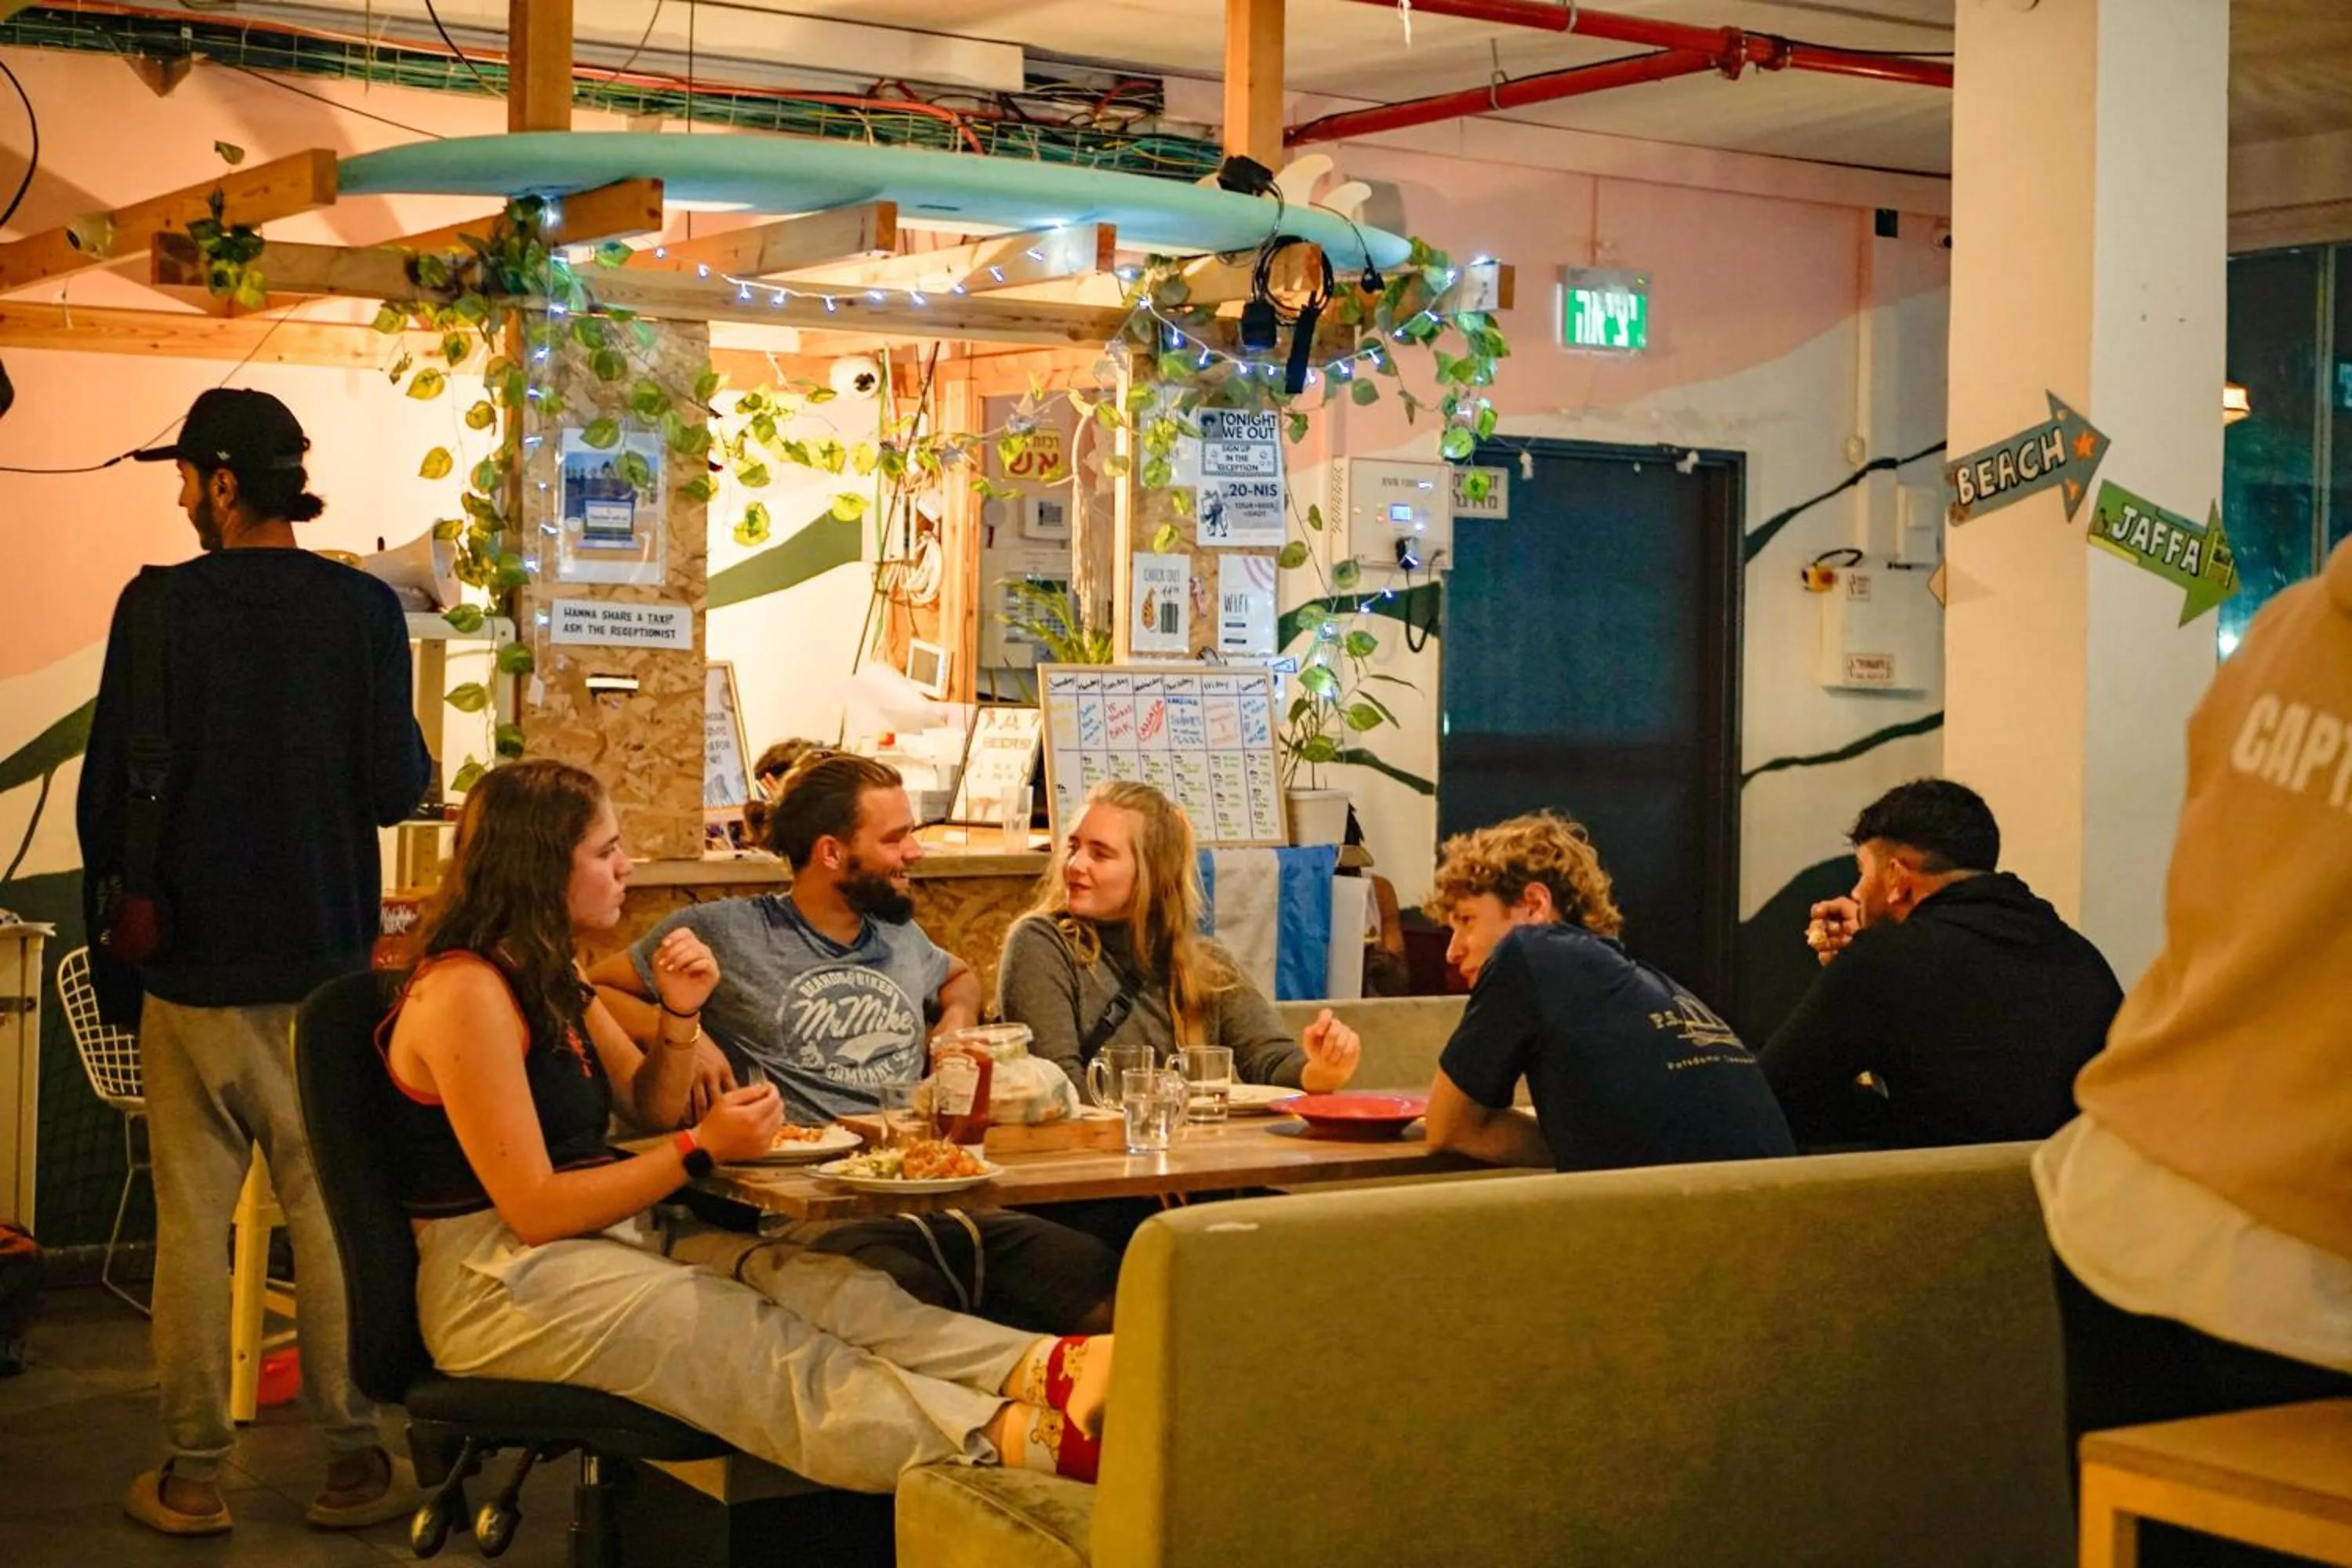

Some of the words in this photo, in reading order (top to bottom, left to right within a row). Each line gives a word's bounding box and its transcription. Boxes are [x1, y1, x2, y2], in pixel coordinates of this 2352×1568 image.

[1575, 289, 1638, 347] יציאה
[1219, 412, 1276, 426] TONIGHT
[1222, 426, 1243, 438] WE
[1247, 426, 1276, 439] OUT
[1956, 426, 2067, 506] BEACH
[1229, 483, 1277, 497] 20-NIS
[2112, 504, 2205, 578] JAFFA
[1223, 593, 1249, 615] WIFI
[601, 610, 633, 622] SHARE
[637, 612, 644, 622] A
[563, 623, 583, 634] ASK
[588, 624, 605, 635] THE
[610, 626, 677, 639] RECEPTIONIST
